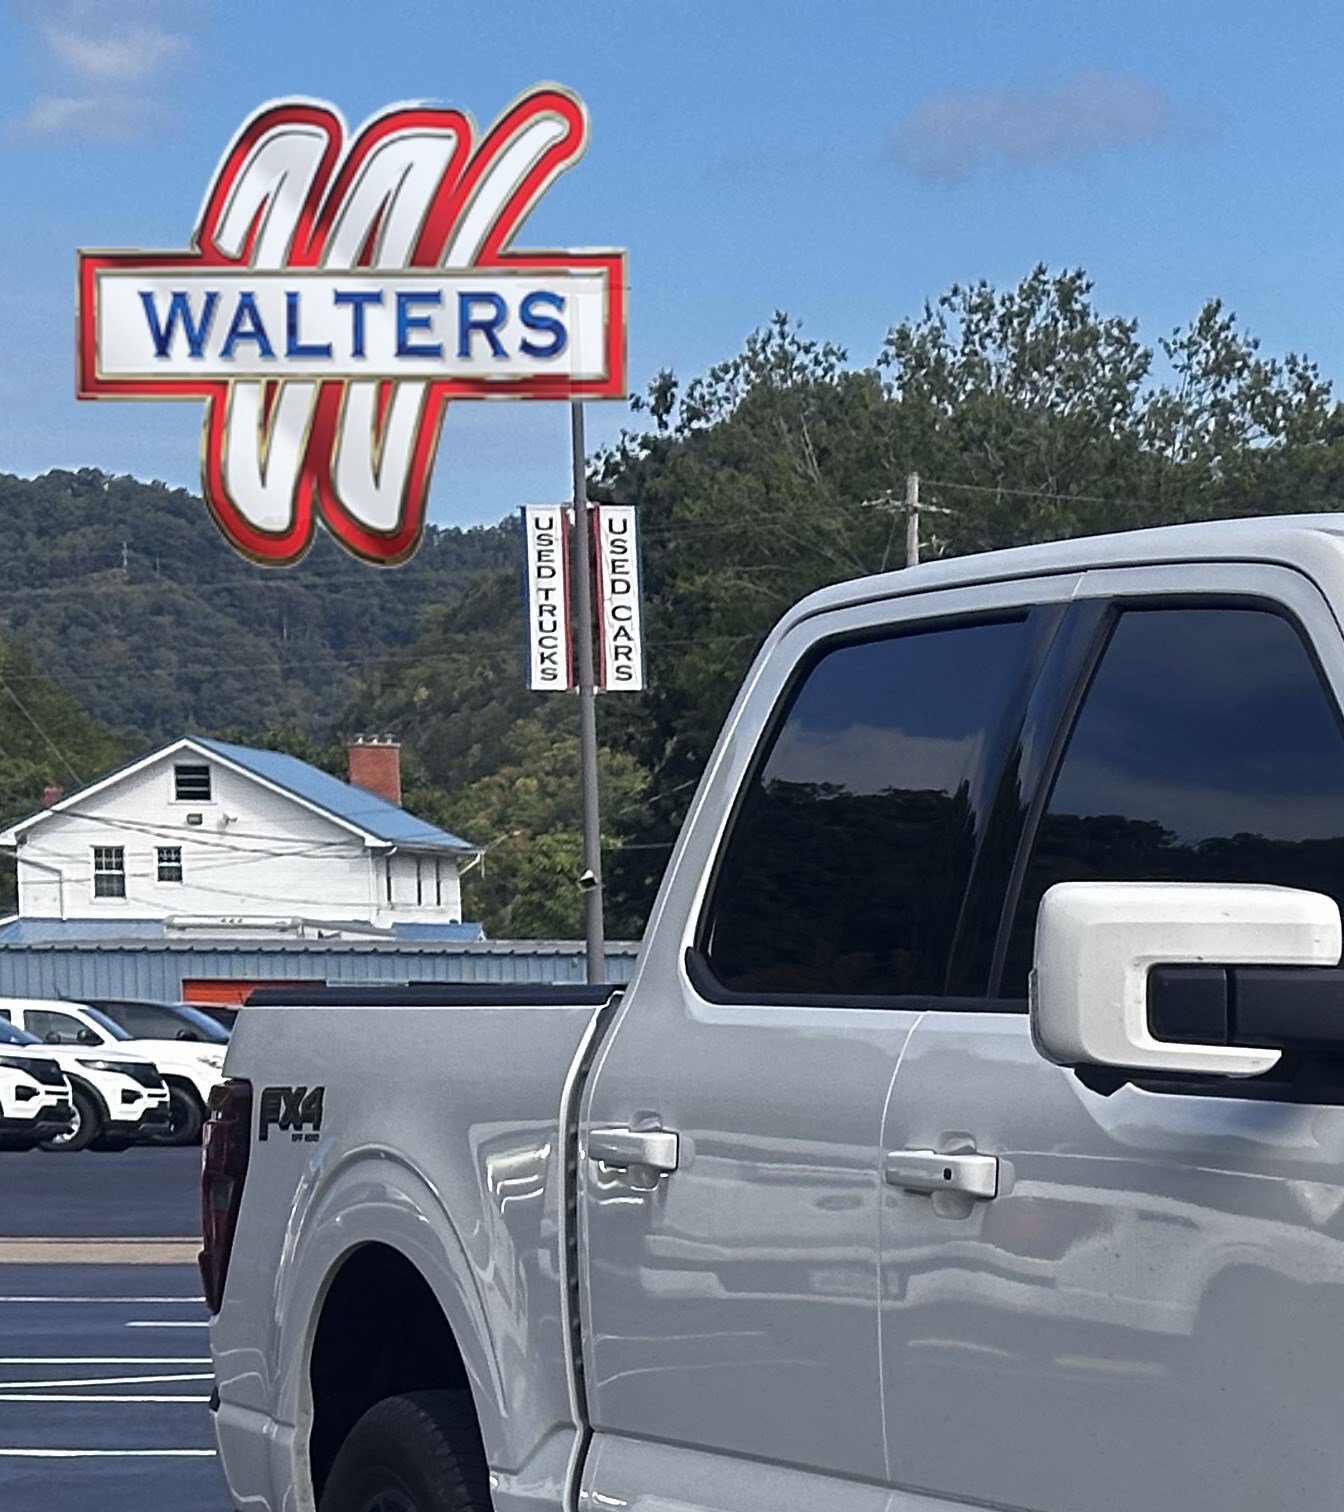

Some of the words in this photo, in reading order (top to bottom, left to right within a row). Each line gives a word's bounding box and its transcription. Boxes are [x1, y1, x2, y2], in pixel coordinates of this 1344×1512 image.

[534, 517, 557, 579] USED
[608, 518, 632, 595] USED
[537, 587, 558, 682] TRUCKS
[611, 605, 634, 682] CARS
[258, 1087, 325, 1141] FX4
